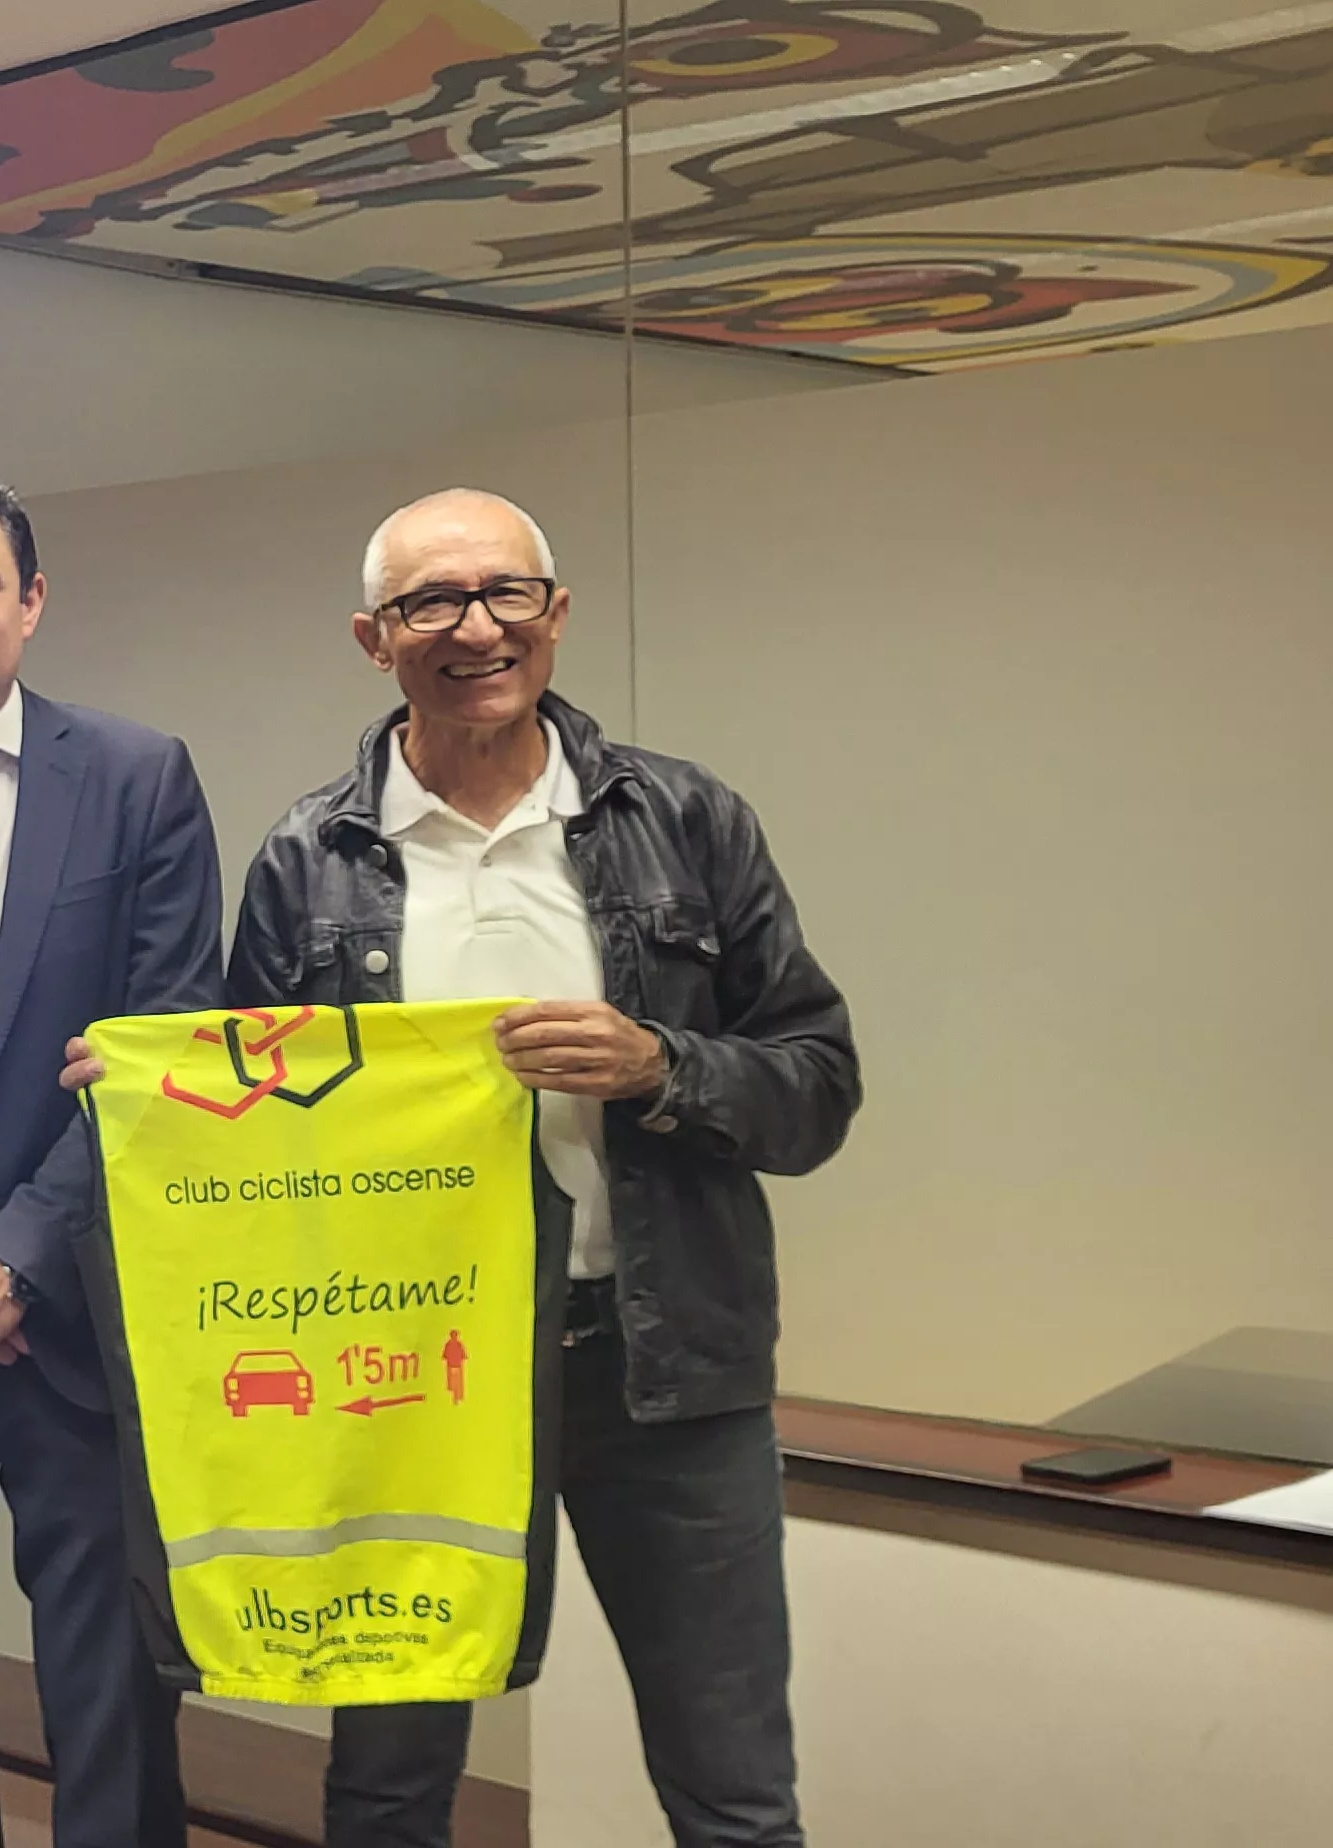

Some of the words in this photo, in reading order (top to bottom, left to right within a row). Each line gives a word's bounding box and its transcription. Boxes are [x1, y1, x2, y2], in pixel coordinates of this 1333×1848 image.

[165, 1176, 230, 1204] club
[240, 1169, 342, 1201] ciclista
[352, 1165, 475, 1194] oscense
[199, 1263, 478, 1334] ¡Respétame!
